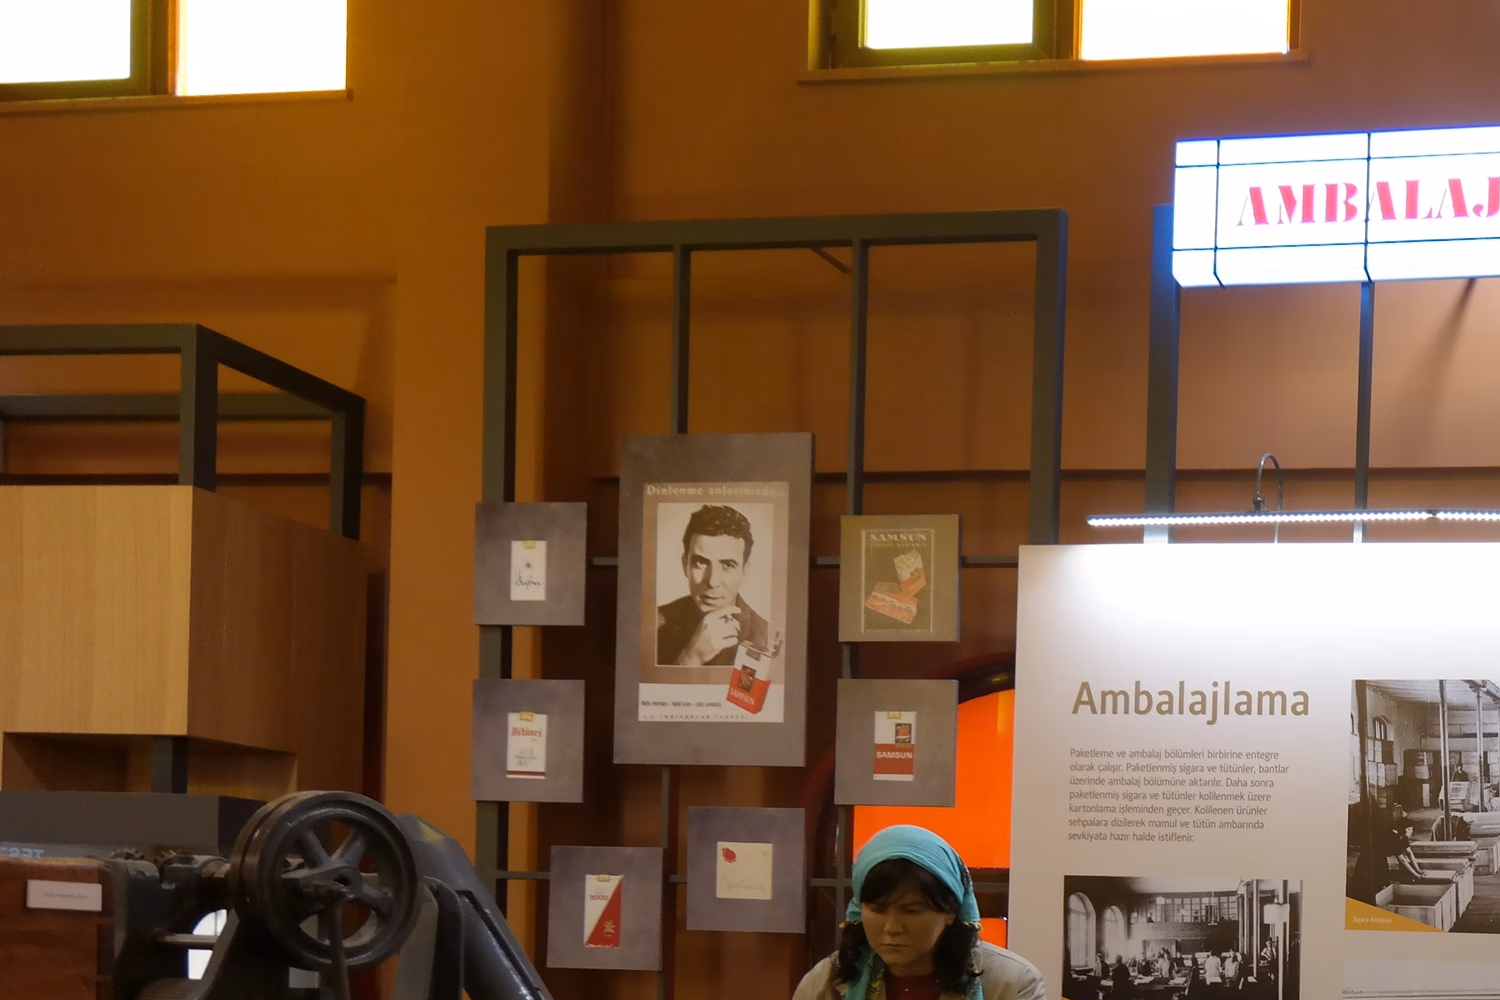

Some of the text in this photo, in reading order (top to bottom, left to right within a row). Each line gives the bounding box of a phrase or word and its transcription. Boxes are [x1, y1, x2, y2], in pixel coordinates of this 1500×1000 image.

[1071, 680, 1309, 725] Ambalajlama
[876, 751, 913, 759] SAMSUN
[1070, 748, 1114, 758] Paketleme
[1128, 748, 1162, 761] ambalaj
[1164, 748, 1205, 759] bölümleri
[1207, 749, 1244, 759] birbirine
[1245, 750, 1280, 762] entegre
[1069, 762, 1290, 775] olarak çalışır. Paketlenmiş sigara ve tütünler, bantlar
[1069, 775, 1274, 788] üzerinde ambalaj bölümüne aktarılır. Daha sonra
[1069, 789, 1272, 802] paketlenmiş sigara ve tütünler kolilenmek üzere
[1069, 803, 1268, 817] kartonlama işleminden geçer. Kolilenen ürünler
[1068, 817, 1264, 829] sehpalara dizilerek mamul ve tütün ambarında
[1068, 830, 1195, 843] sevkiyata hazır halde istiflenir.
